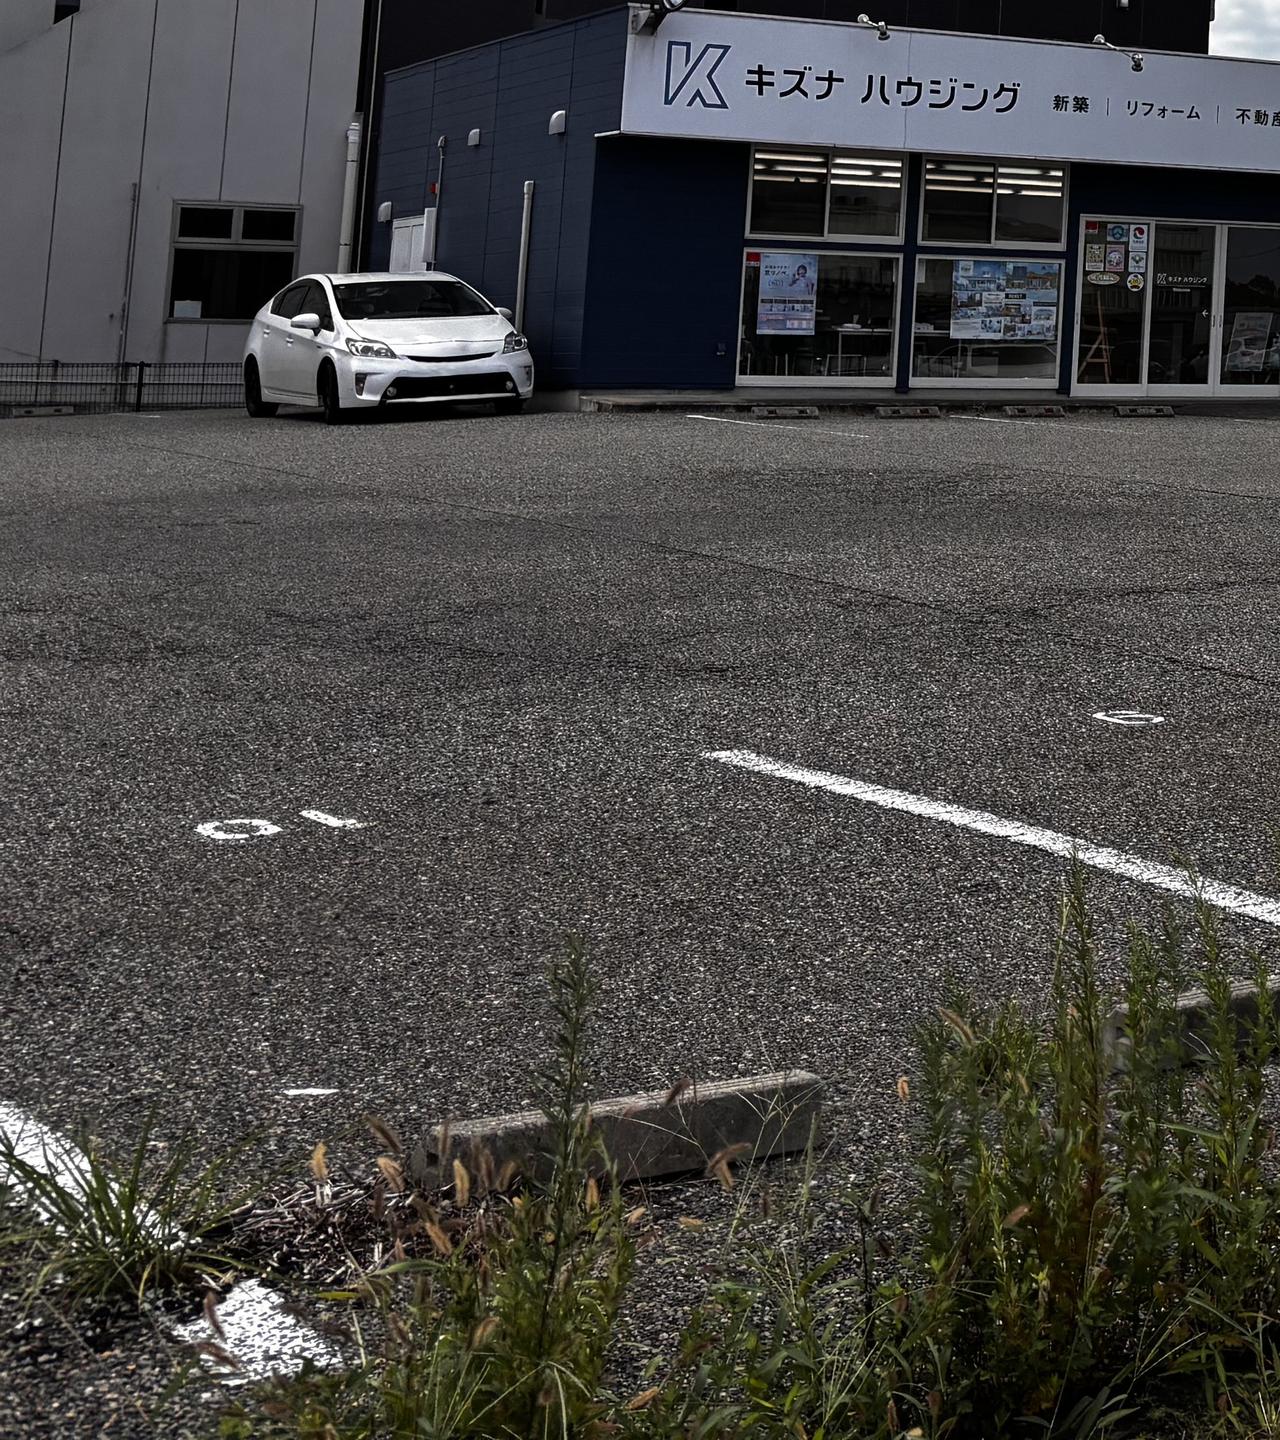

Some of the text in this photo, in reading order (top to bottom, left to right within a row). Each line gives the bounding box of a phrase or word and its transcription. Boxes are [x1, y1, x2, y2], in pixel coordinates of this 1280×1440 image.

[745, 64, 1021, 113] キズナ ハウジング
[1053, 94, 1089, 114] 新築
[1127, 100, 1200, 120] リフォーム
